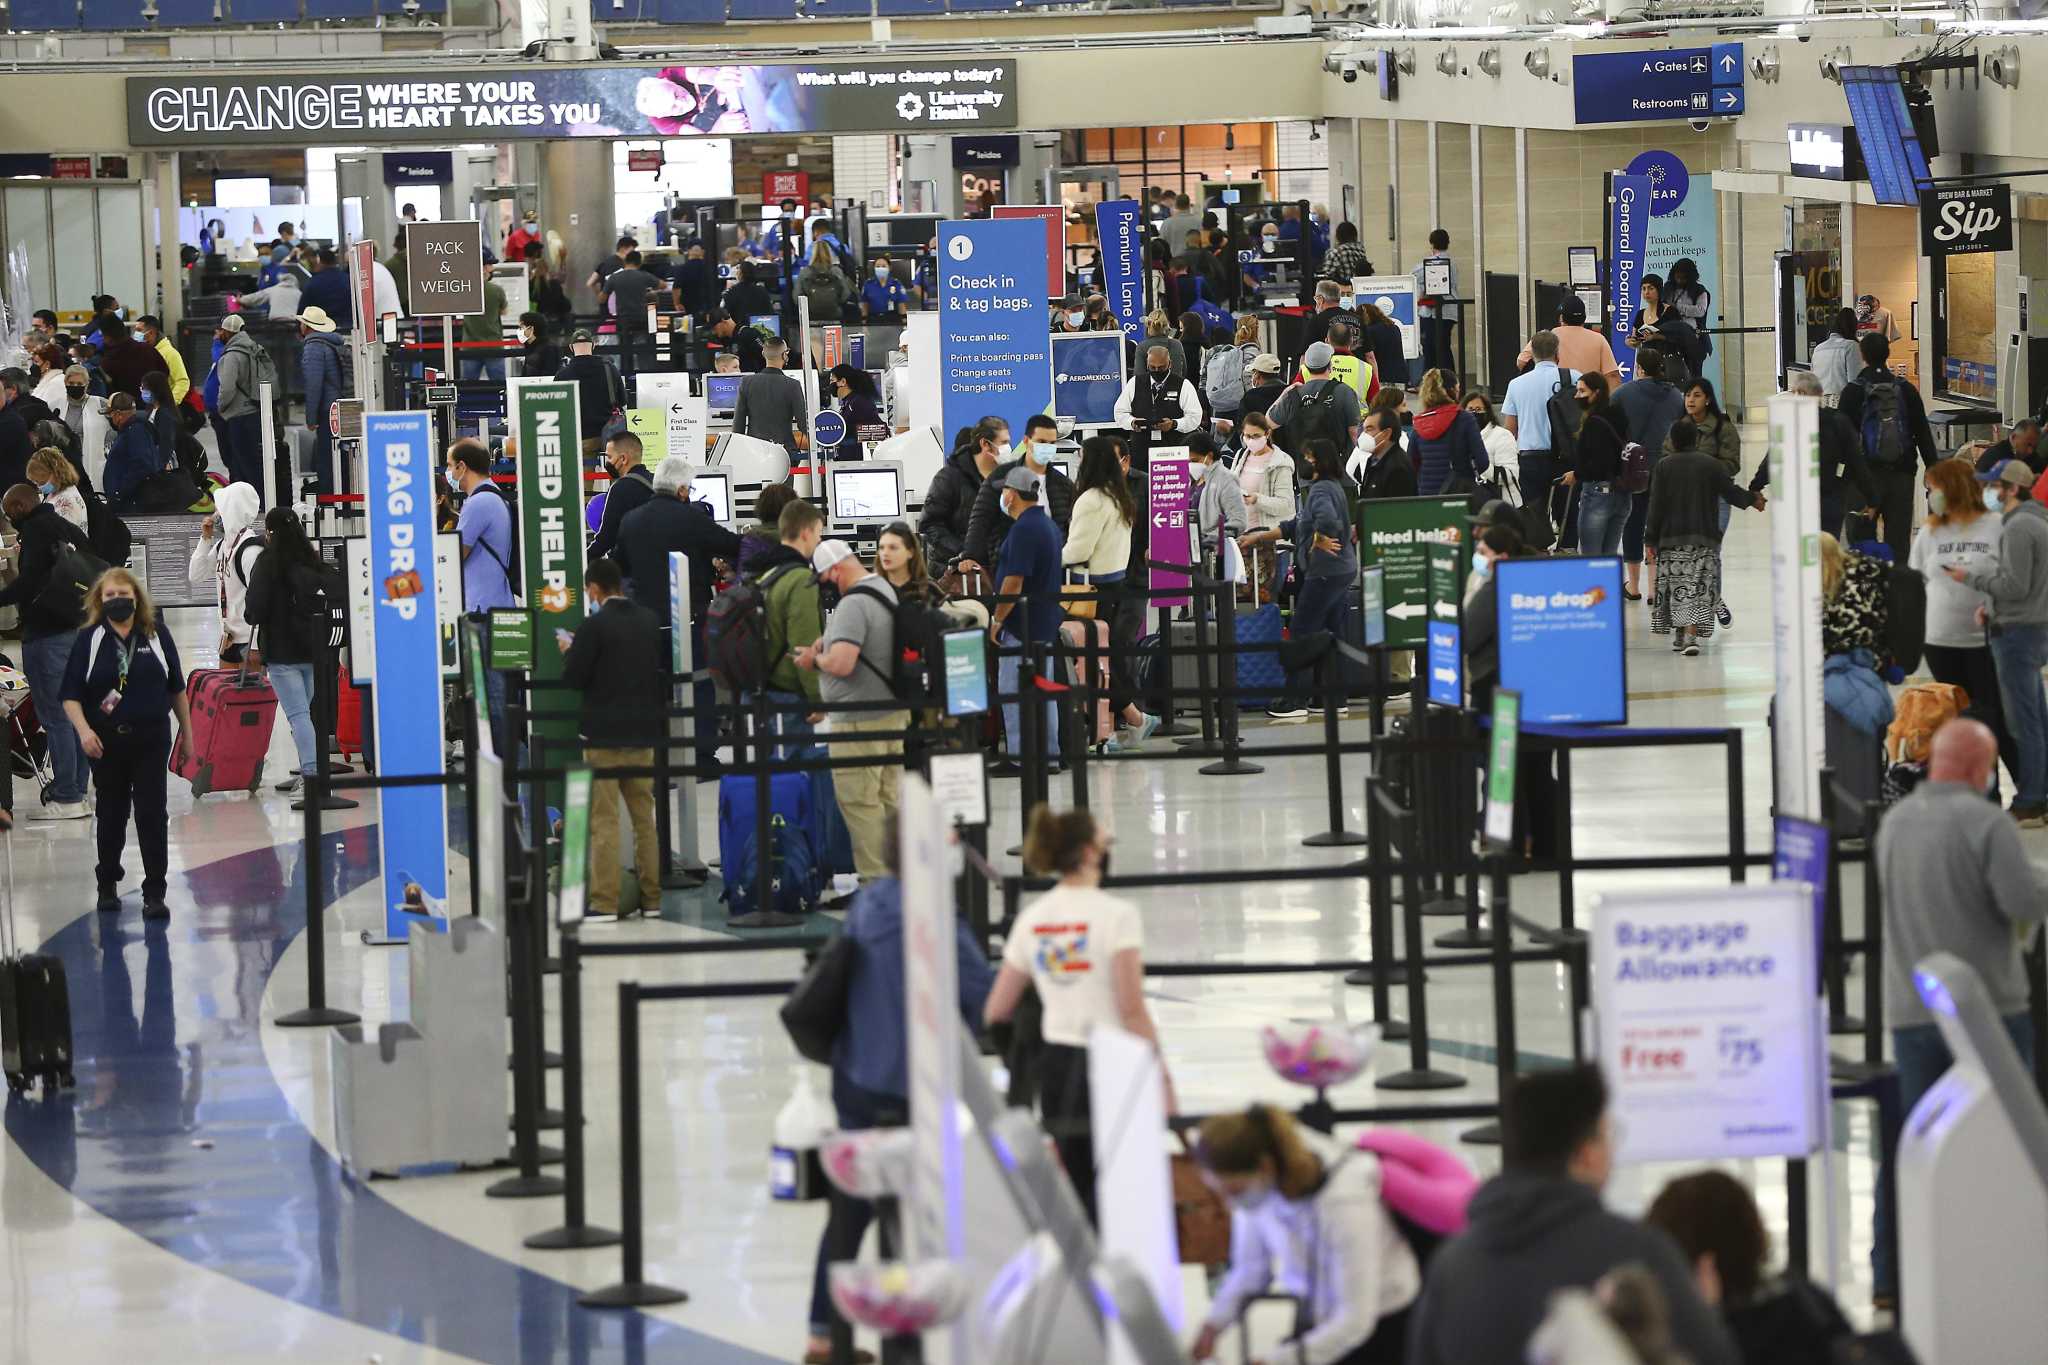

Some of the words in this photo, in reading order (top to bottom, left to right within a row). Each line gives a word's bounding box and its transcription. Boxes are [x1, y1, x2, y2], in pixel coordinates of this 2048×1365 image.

[1642, 62, 1652, 73] A
[1655, 61, 1688, 72] Gates
[797, 73, 836, 85] What
[838, 72, 867, 84] will
[868, 73, 896, 87] you
[898, 70, 951, 85] change
[953, 68, 1003, 84] today?
[366, 83, 462, 104] WHERE
[466, 81, 536, 103] YOUR
[928, 90, 1003, 108] University
[148, 85, 363, 132] CHANGE
[1632, 98, 1688, 110] Restrooms
[368, 106, 456, 128] HEART
[460, 104, 545, 127] TAKES
[549, 103, 600, 124] YOU
[929, 105, 979, 120] Health
[408, 166, 434, 176] leidos
[1653, 190, 1678, 199] EAR
[1938, 191, 1954, 200] BREW
[1954, 190, 1966, 198] BAR
[1971, 188, 1993, 197] MARKET
[1620, 187, 1635, 253] General
[1933, 201, 2001, 241] Sip
[1119, 212, 1133, 276] Premium
[1648, 234, 1693, 245] Touchless
[426, 242, 464, 254] PACK
[956, 242, 963, 254] 1
[1662, 247, 1680, 256] that
[1681, 246, 1706, 257] keeps
[440, 261, 452, 274] &
[1647, 263, 1663, 272] you
[420, 280, 472, 293] WEIGH
[949, 275, 997, 289] Check
[1001, 275, 1015, 287] in
[1121, 282, 1137, 317] Lane
[1616, 260, 1634, 333] Boarding
[950, 297, 961, 310] &
[965, 298, 989, 312] tag
[993, 296, 1032, 312] bags.
[1123, 322, 1138, 335] &
[950, 334, 968, 342] You
[988, 333, 1010, 341] also:
[950, 354, 972, 362] Print
[981, 353, 1021, 362] boarding
[1023, 353, 1044, 363] pass
[951, 369, 987, 378] Change
[988, 368, 1012, 376] seats
[951, 384, 986, 393] Change
[988, 382, 1017, 393] flights
[526, 391, 568, 400] FRONTIER
[374, 422, 420, 431] FRONTIER
[535, 411, 563, 500] NEED
[385, 443, 414, 516] BAG
[1158, 491, 1185, 500] equipaje
[1371, 530, 1413, 545] Need
[1415, 527, 1457, 543] help?
[540, 507, 569, 610] HELP?
[381, 523, 417, 620] DRP
[1510, 593, 1546, 611] Bag
[1550, 591, 1595, 609] drop
[1615, 921, 1749, 953] Baggage
[1617, 956, 1777, 982] Allowance
[1621, 1045, 1686, 1069] Free
